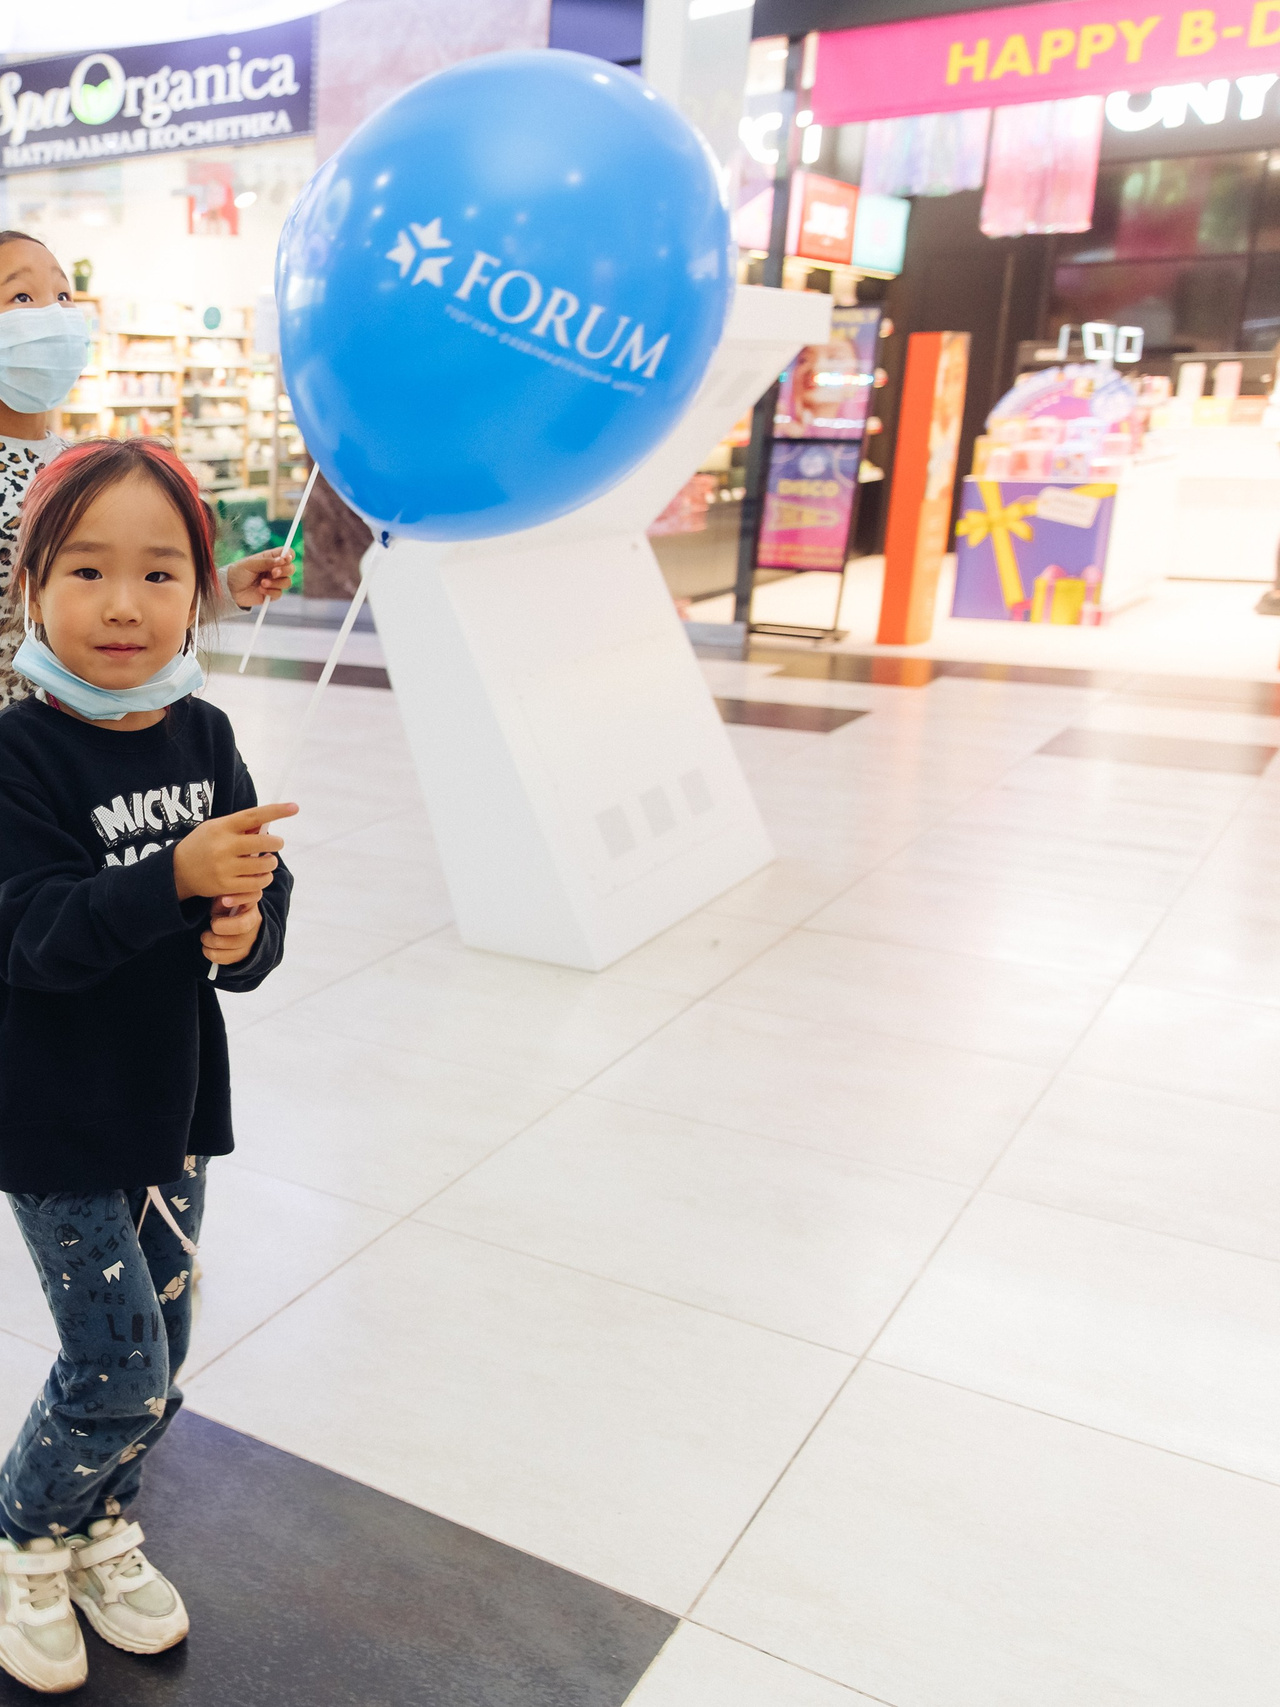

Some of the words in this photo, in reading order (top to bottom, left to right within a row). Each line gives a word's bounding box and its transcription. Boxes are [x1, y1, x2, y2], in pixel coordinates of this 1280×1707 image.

[946, 15, 1162, 85] HAPPY
[149, 108, 293, 150] КОСМЕТИКА
[1104, 73, 1279, 132] ONY
[454, 250, 670, 379] FORUM
[91, 780, 216, 846] MICKEY
[89, 1290, 126, 1305] YES
